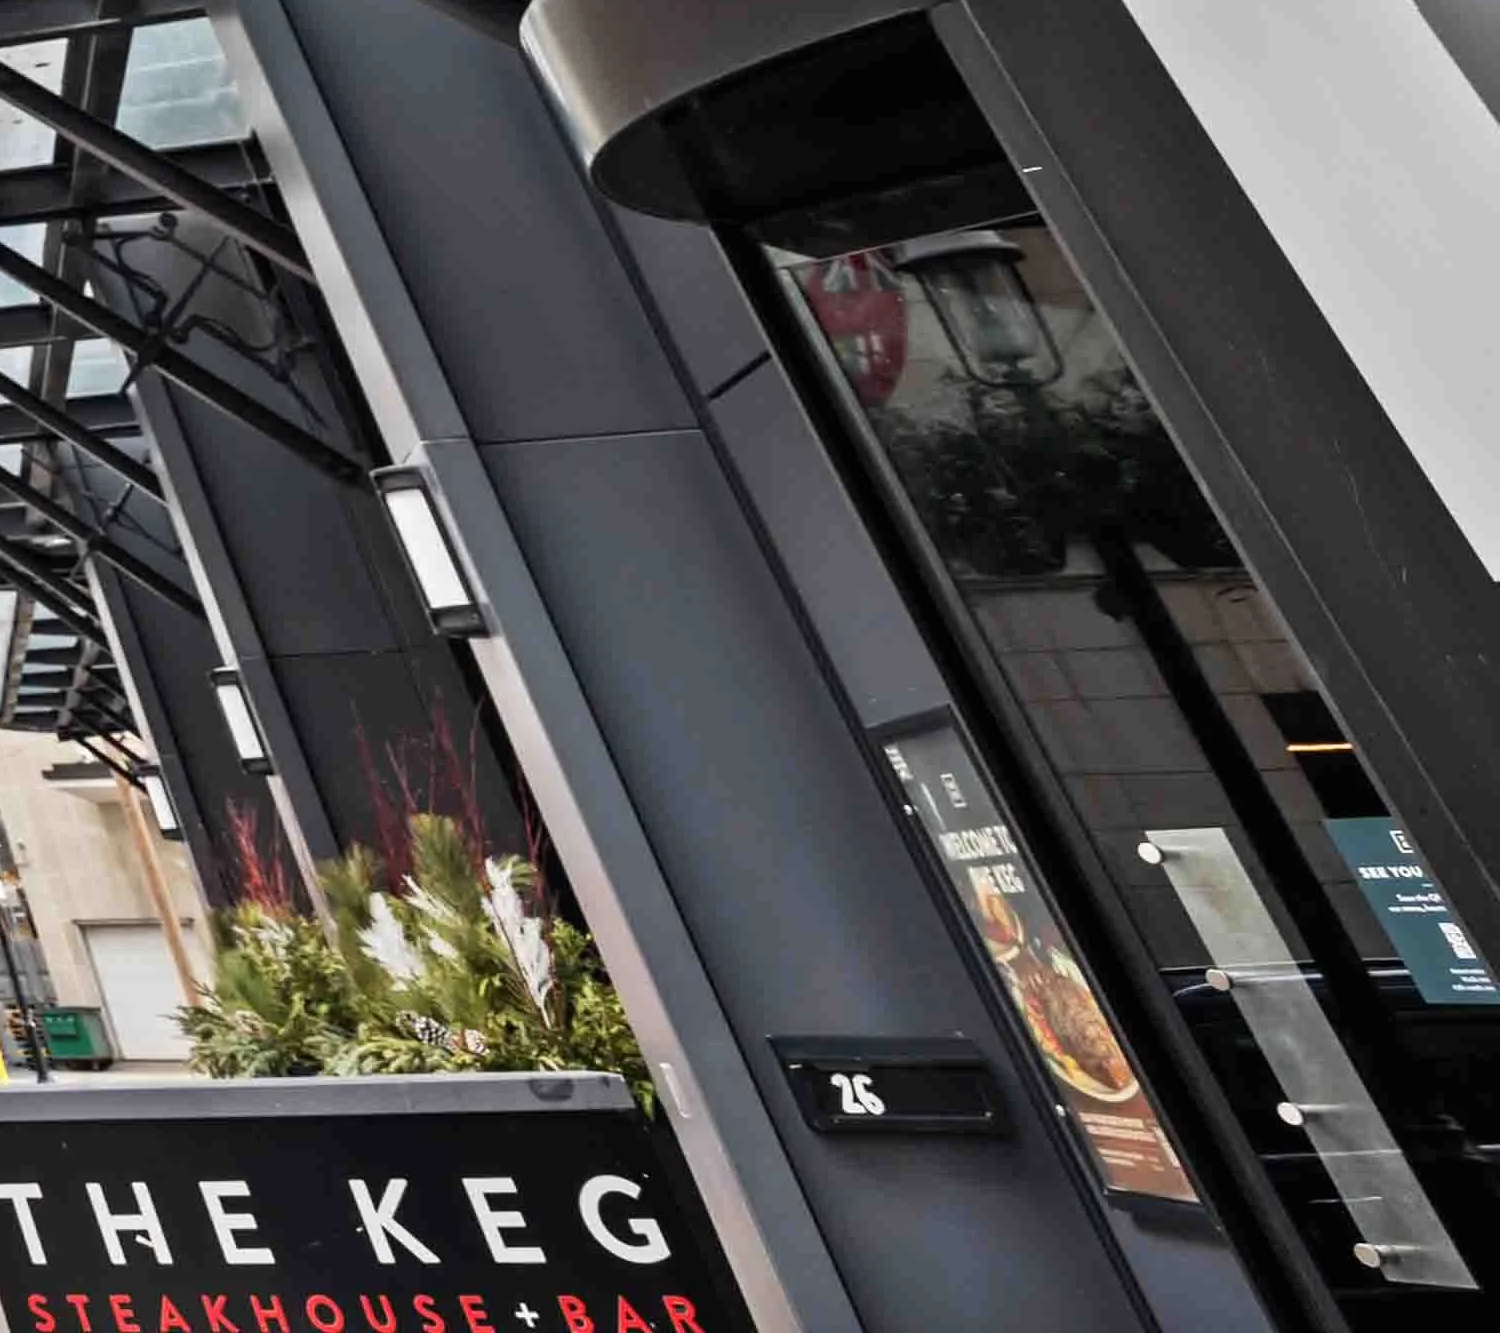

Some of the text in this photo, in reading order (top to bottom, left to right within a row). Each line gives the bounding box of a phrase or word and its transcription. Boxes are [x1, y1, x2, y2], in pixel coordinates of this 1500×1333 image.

[1358, 865, 1424, 880] SEE YOU
[830, 1072, 886, 1116] 26
[348, 1175, 671, 1264] KEG
[27, 1293, 496, 1333] STEAKHOUSE
[557, 1295, 706, 1333] BAR
